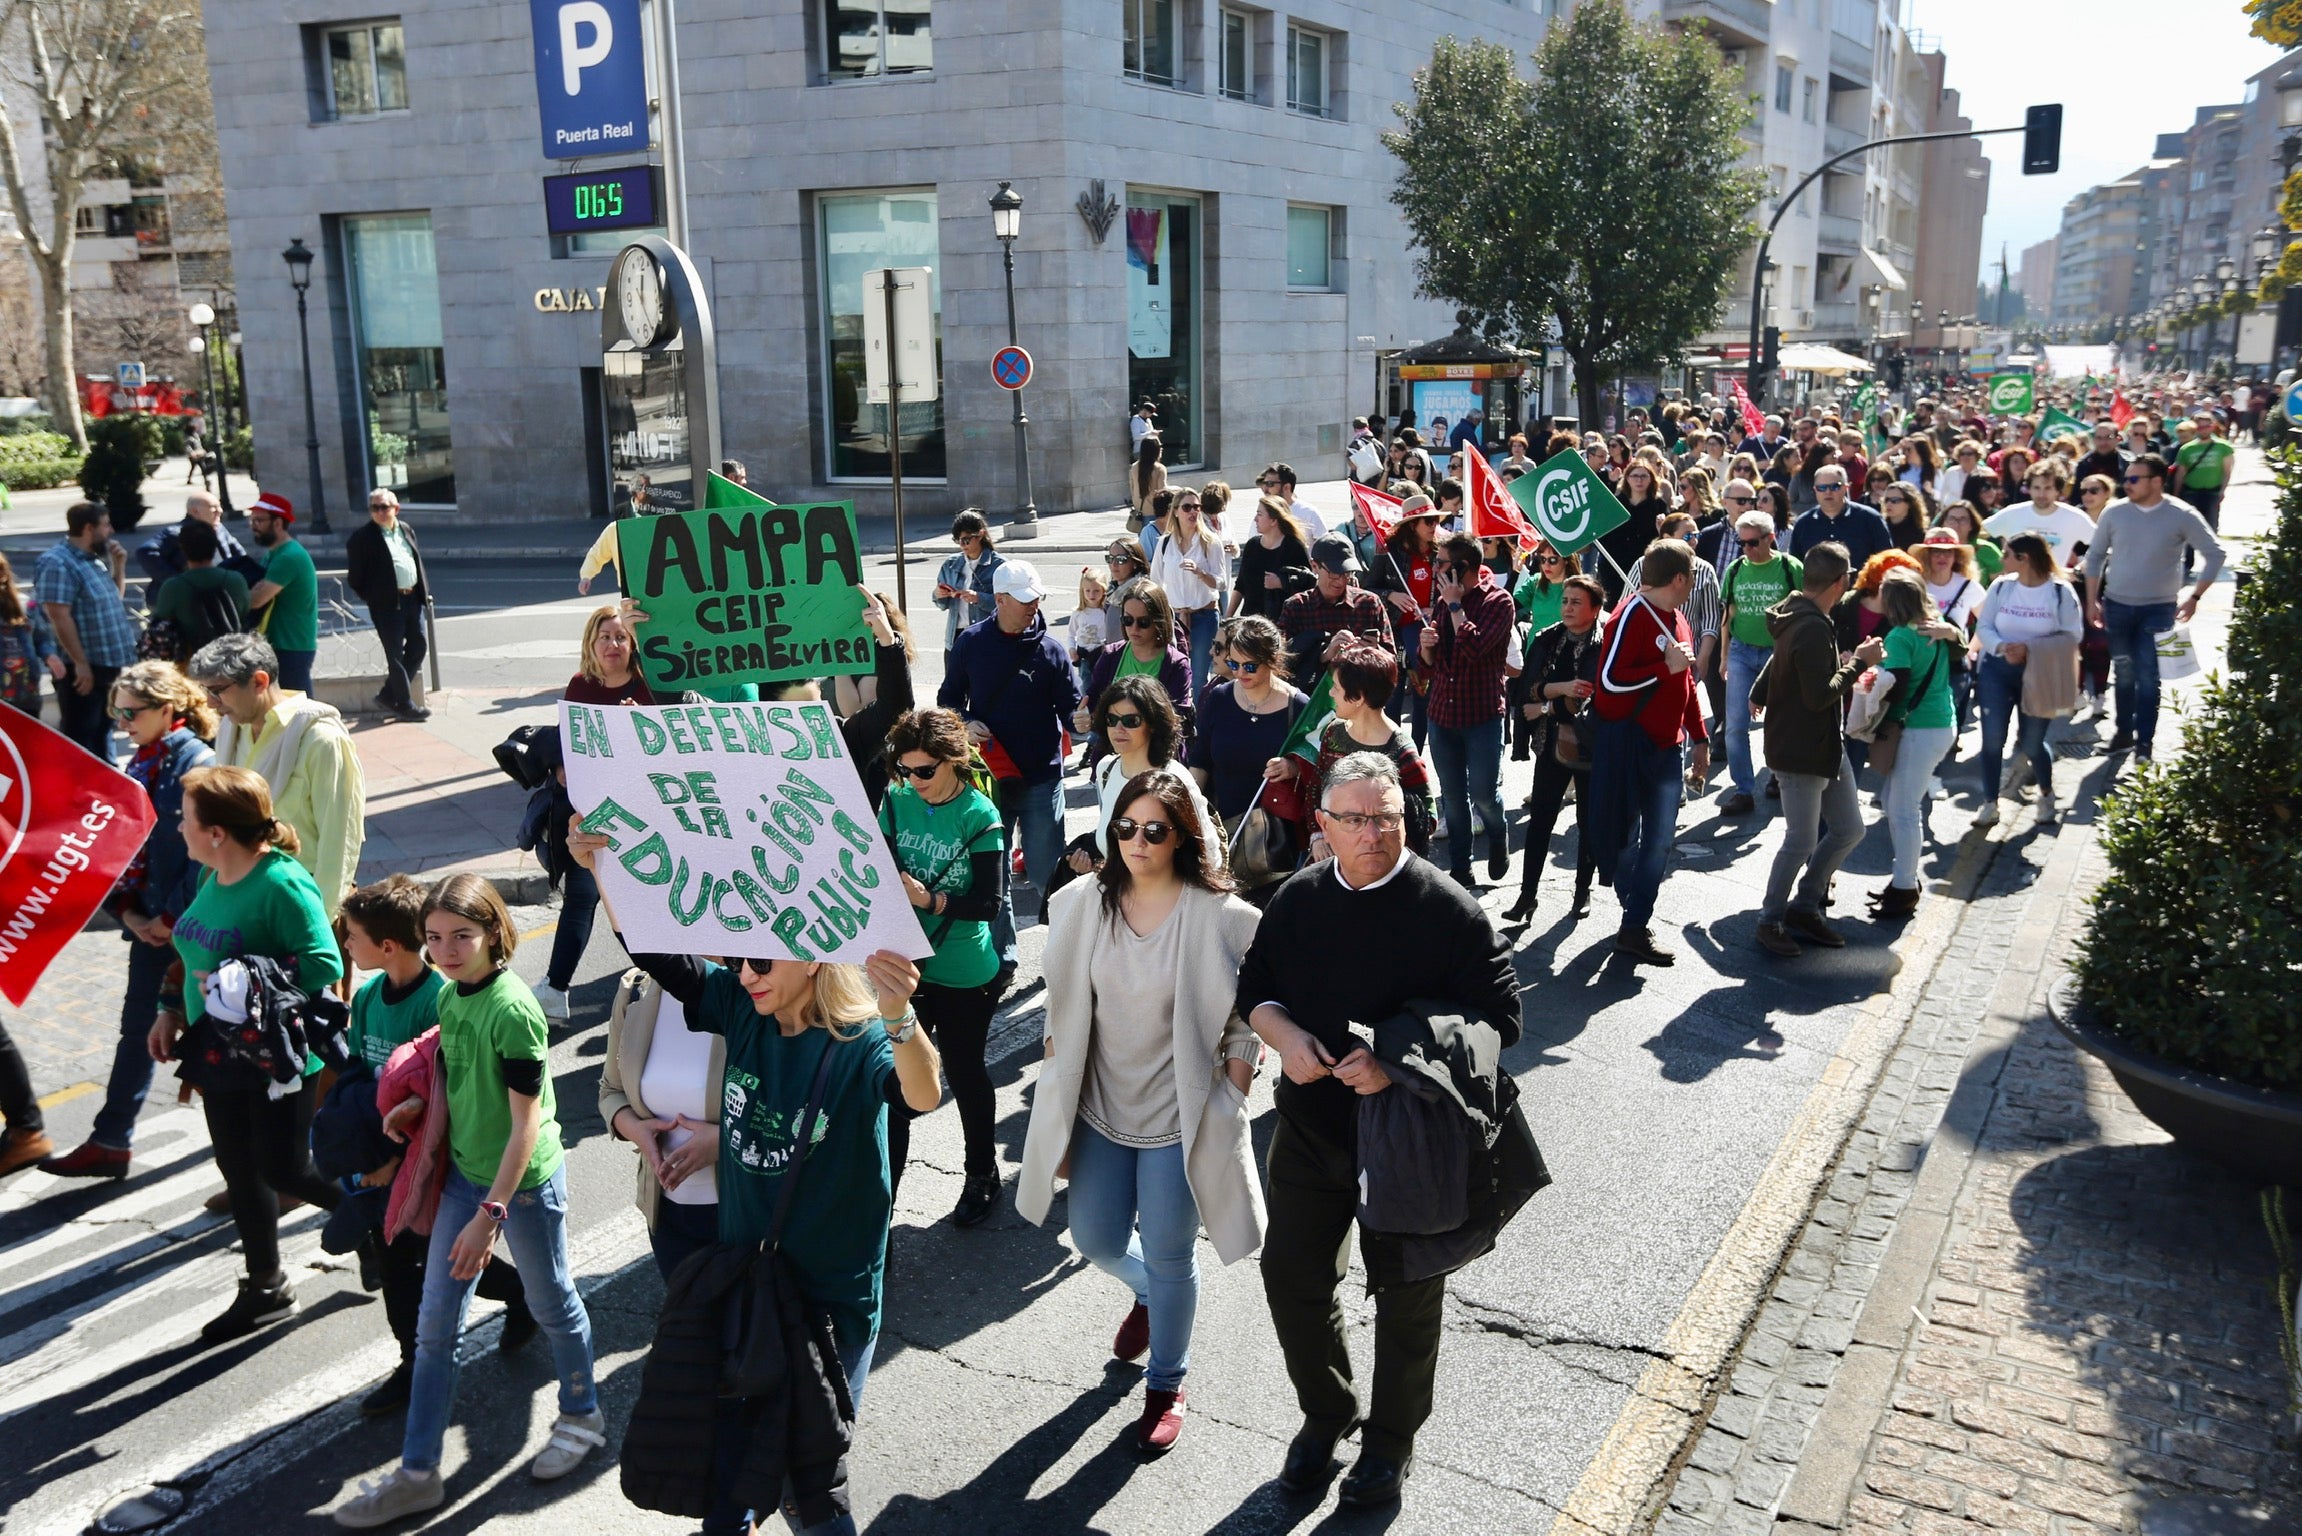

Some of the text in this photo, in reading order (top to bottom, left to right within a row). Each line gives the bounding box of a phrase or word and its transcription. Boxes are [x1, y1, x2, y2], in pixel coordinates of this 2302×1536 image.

[558, 1, 614, 96] P
[556, 121, 633, 145] Puerta Real
[574, 182, 624, 220] 065
[534, 287, 594, 313] CAJA
[1423, 396, 1472, 409] JUGAMOS
[1548, 477, 1590, 522] CSIF
[568, 705, 843, 761] EN DEFENSA
[647, 771, 721, 804] DE
[672, 806, 733, 839] LA
[0, 798, 116, 964] www.ugt.es
